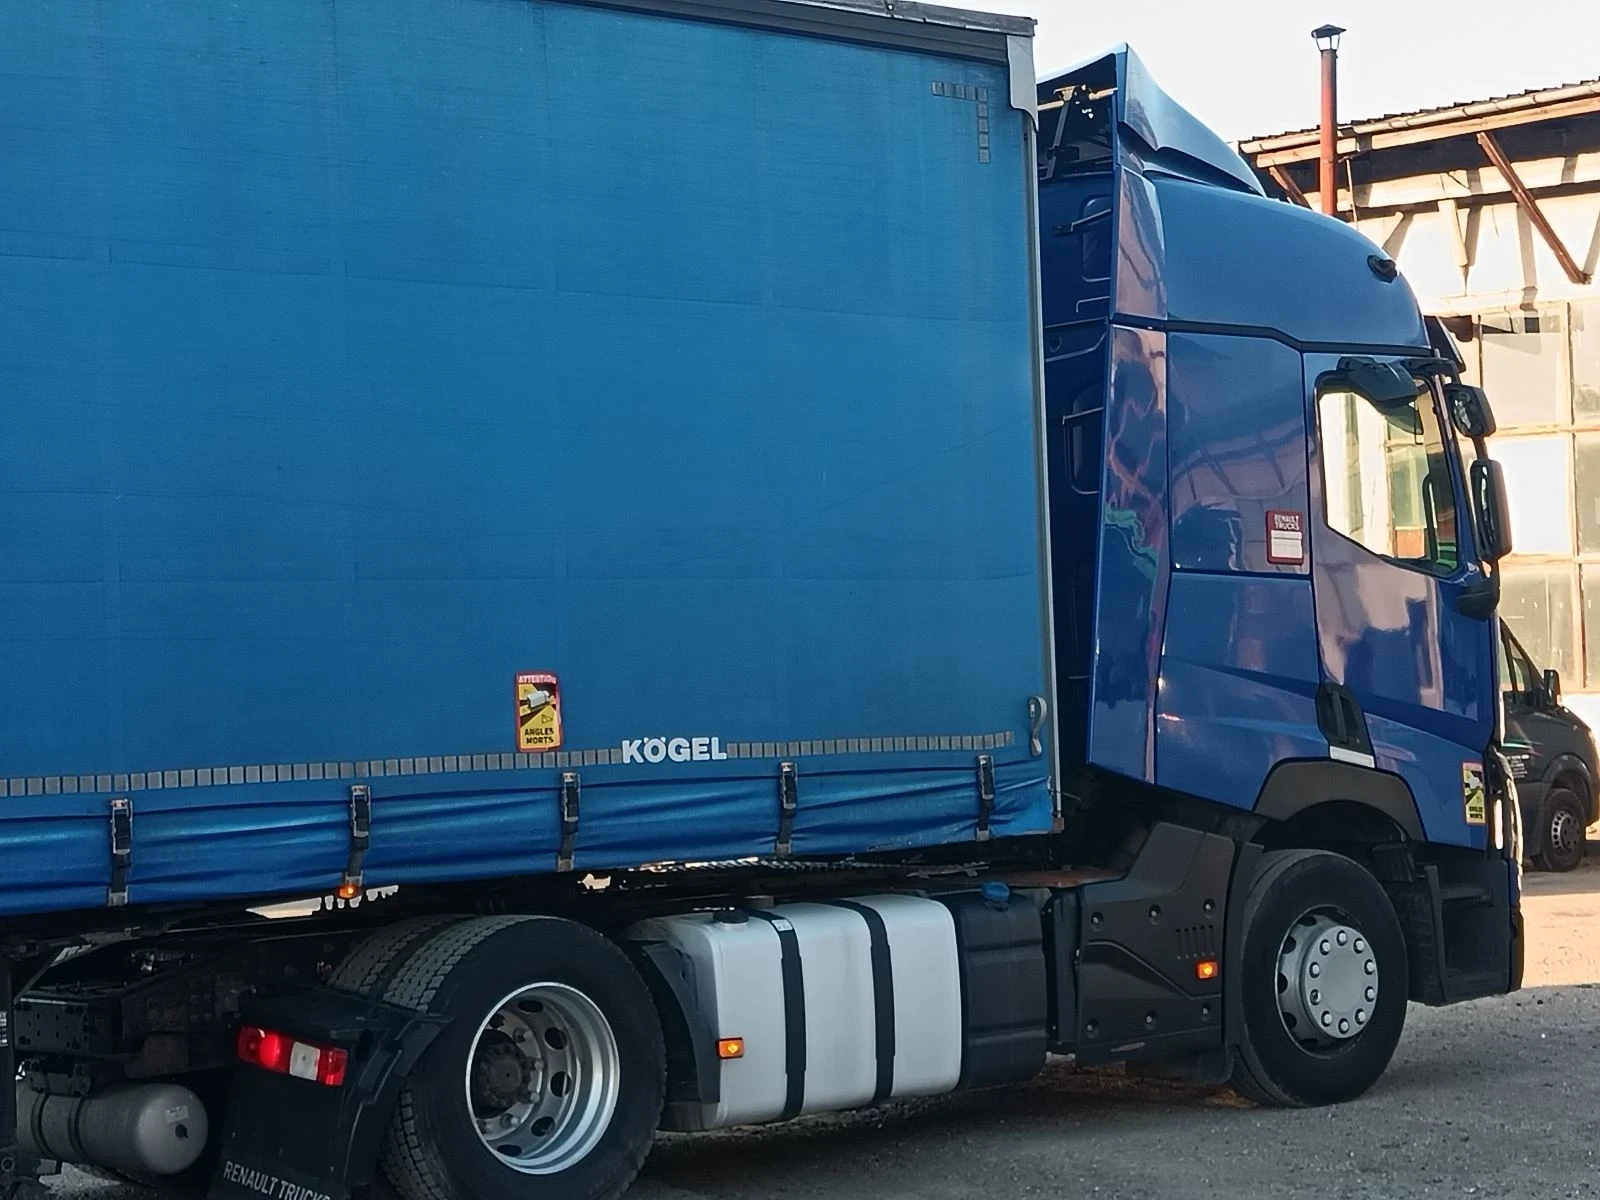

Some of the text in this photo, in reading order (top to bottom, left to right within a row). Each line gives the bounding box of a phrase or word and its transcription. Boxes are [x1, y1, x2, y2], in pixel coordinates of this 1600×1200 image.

[518, 675, 557, 684] ATTENTION
[524, 727, 554, 736] ANGLES
[526, 736, 554, 744] MORTS
[622, 736, 727, 764] KÖGEL
[223, 1160, 331, 1200] RENAULT TRUC
